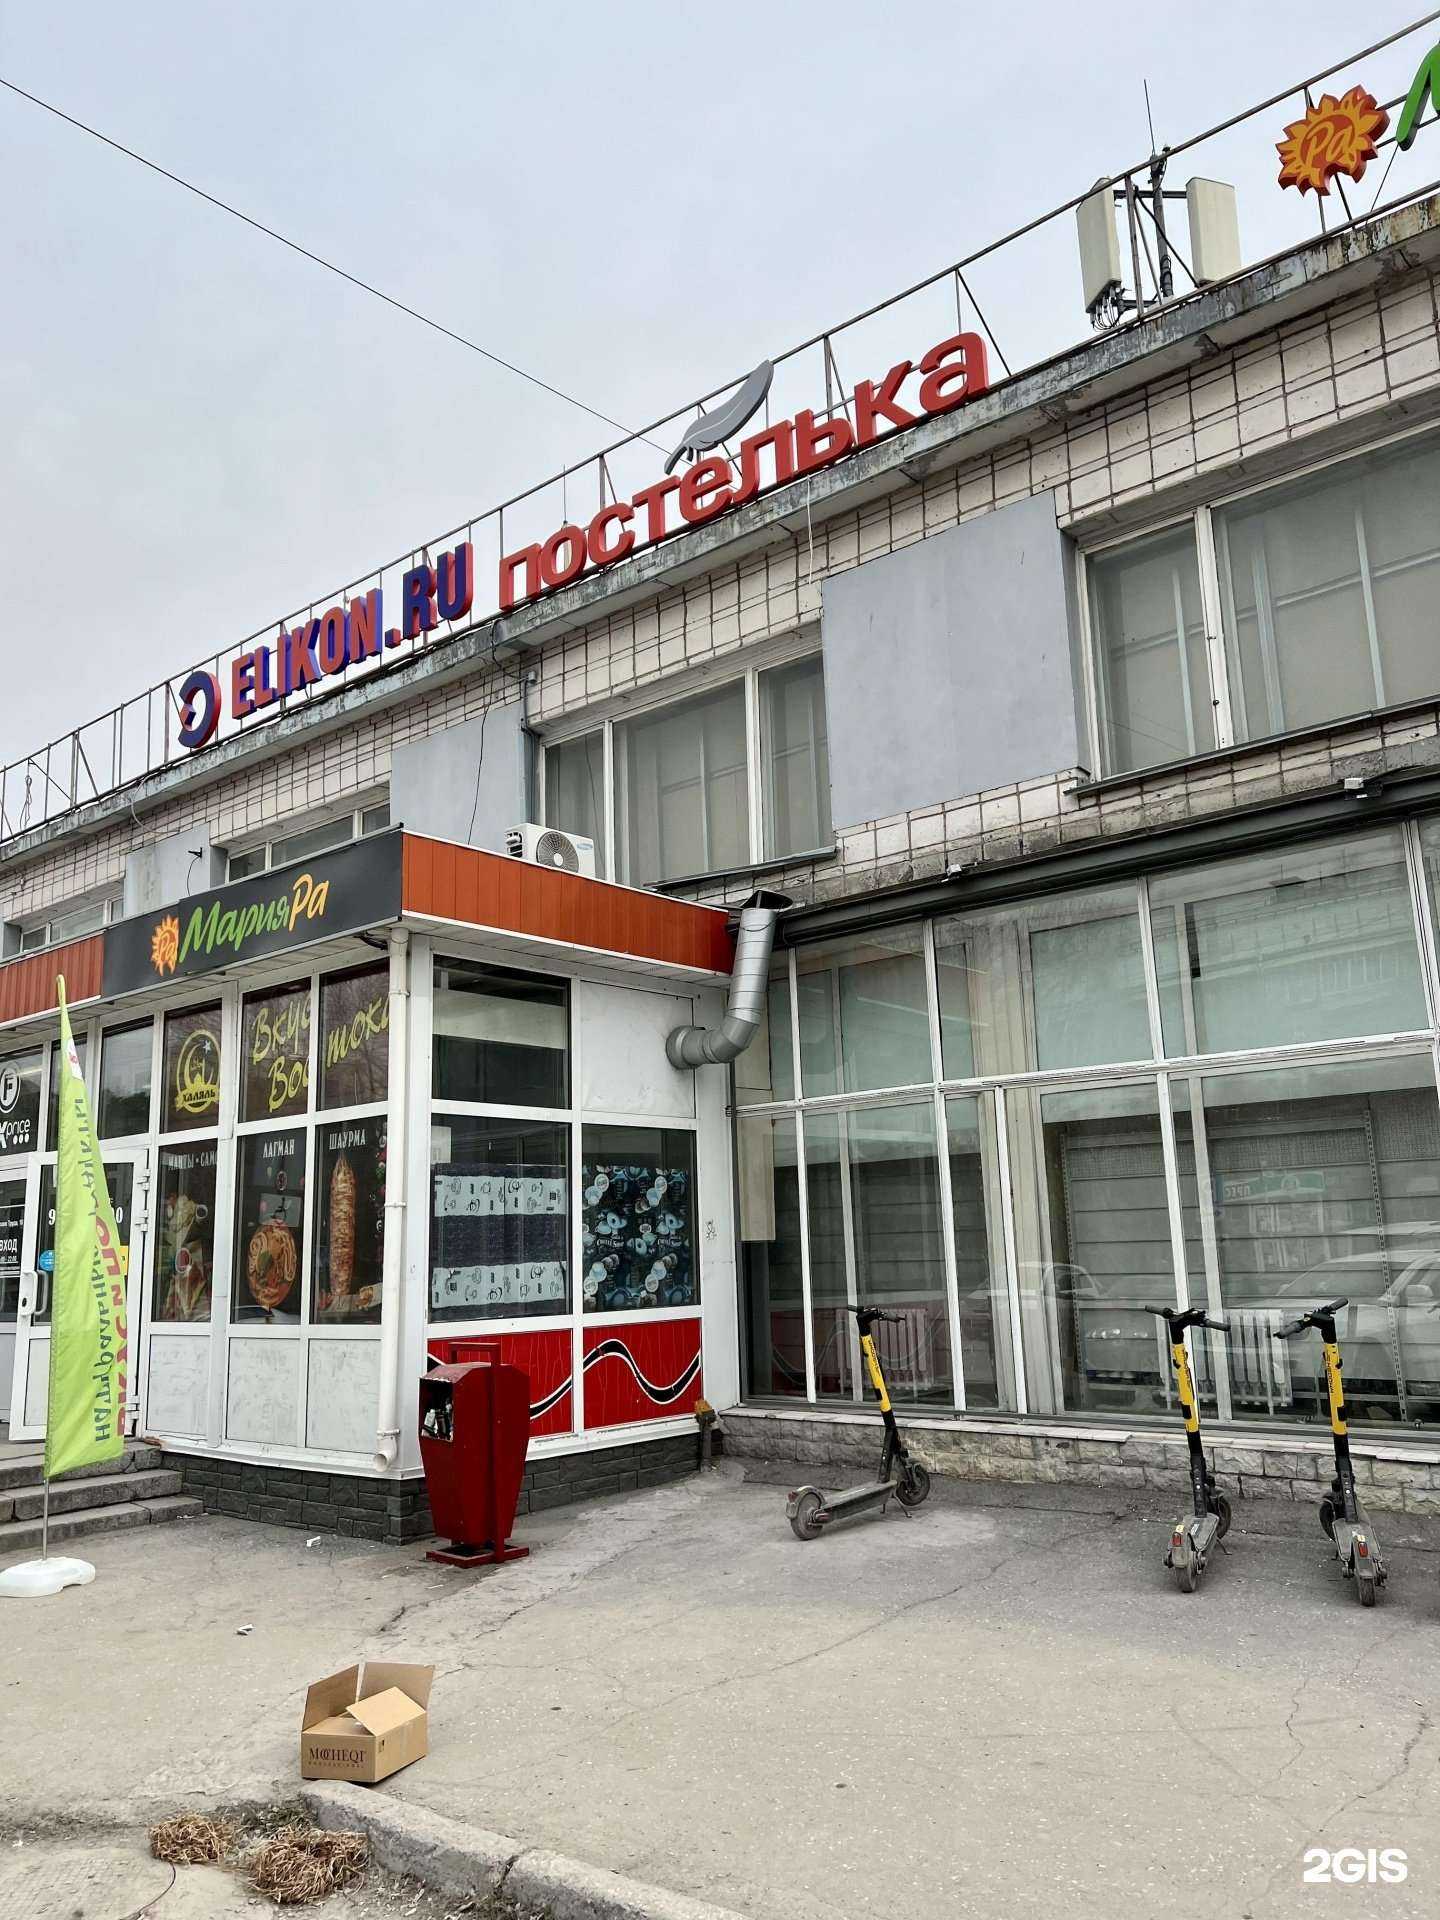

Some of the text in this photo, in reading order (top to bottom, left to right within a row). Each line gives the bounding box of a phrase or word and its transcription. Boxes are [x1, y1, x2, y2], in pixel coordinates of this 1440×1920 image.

[499, 331, 989, 611] постелька
[231, 541, 474, 720] ELIKON.RU
[263, 1138, 295, 1158] ЛАГМАН
[329, 1128, 366, 1149] ШАУРМА
[200, 1151, 217, 1167] САМ
